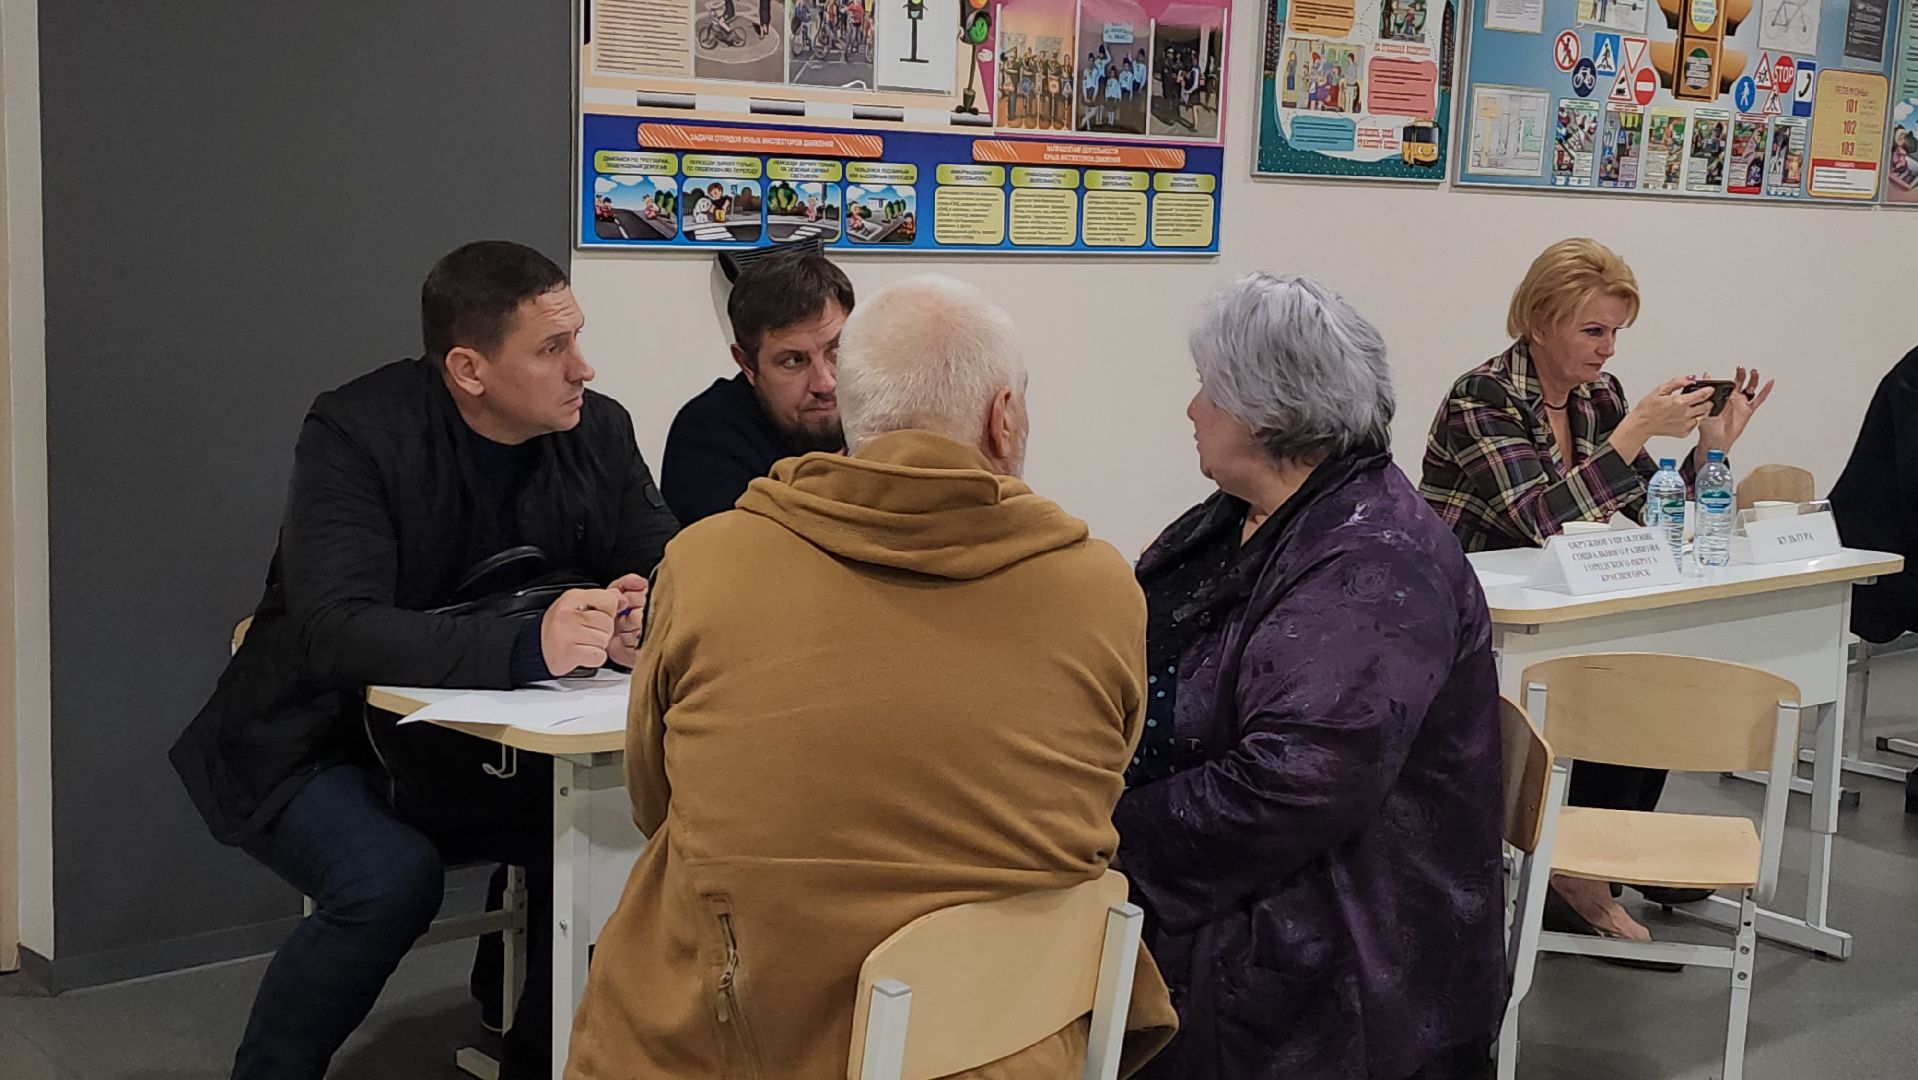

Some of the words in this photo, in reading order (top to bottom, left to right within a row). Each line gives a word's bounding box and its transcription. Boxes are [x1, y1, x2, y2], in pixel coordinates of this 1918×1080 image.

[1774, 66, 1794, 83] STOP
[1846, 99, 1858, 113] 101
[1843, 120, 1857, 135] 102
[1841, 142, 1855, 156] 103
